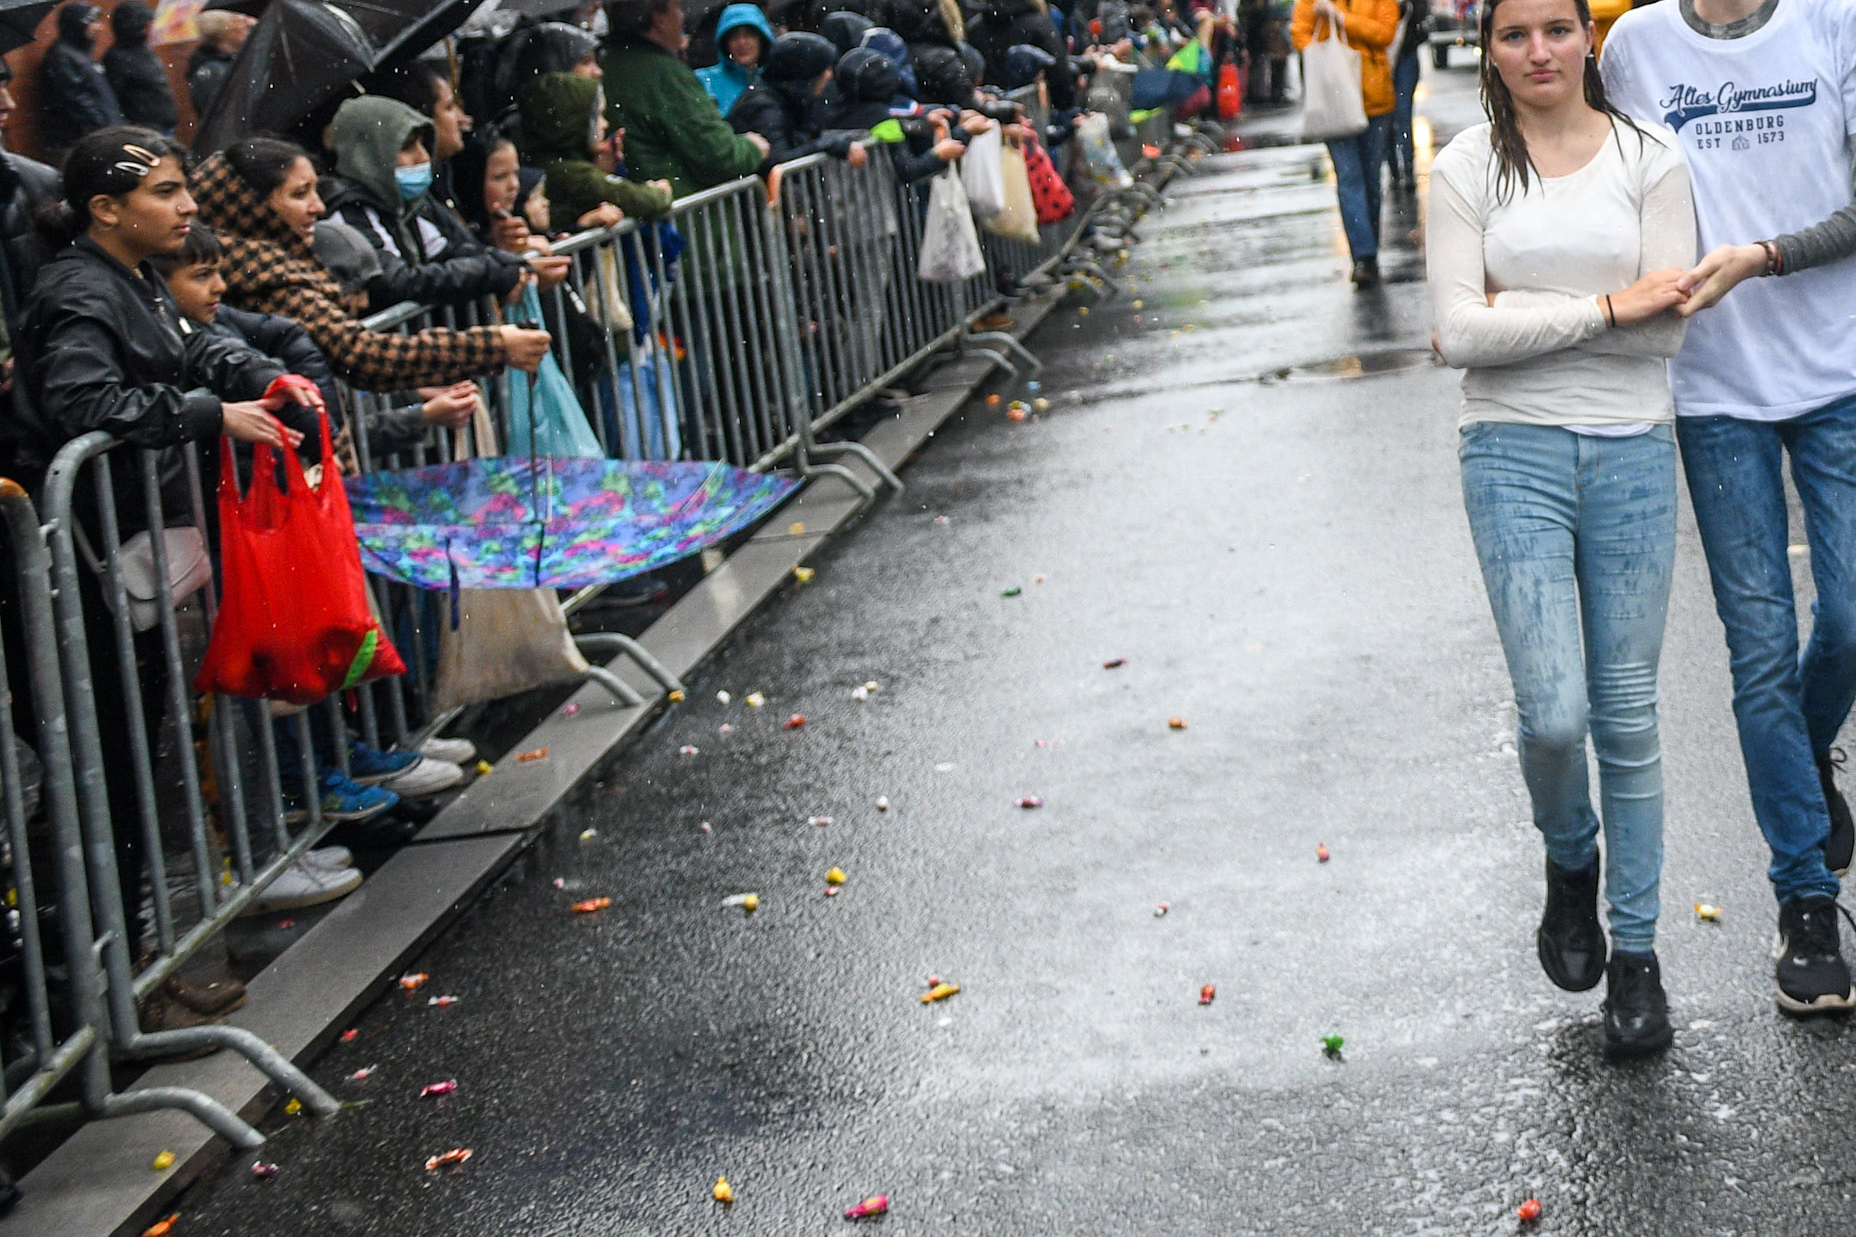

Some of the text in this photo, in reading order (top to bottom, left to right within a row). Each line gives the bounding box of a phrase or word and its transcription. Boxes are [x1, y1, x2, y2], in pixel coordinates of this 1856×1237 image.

[1659, 77, 1819, 117] Altes Gymnasium
[1695, 114, 1785, 136] OLDENBURG
[1697, 130, 1785, 150] EST 1573
